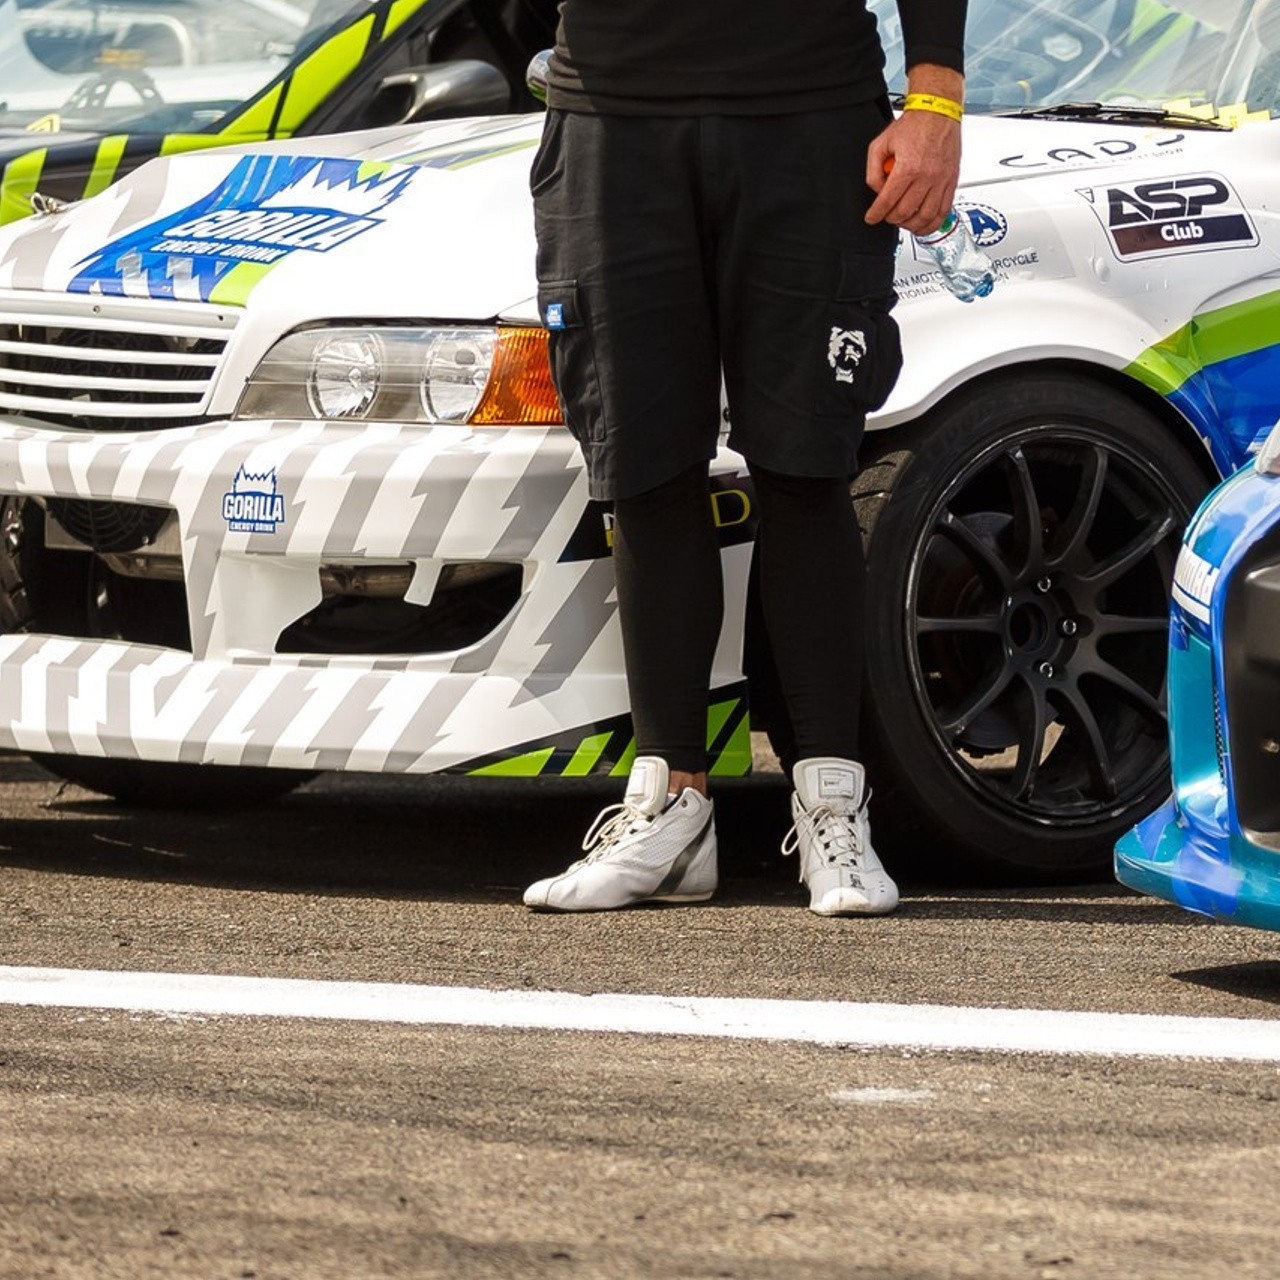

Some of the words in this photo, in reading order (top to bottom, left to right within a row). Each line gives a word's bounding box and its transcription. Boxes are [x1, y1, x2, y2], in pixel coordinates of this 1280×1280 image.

[1107, 177, 1230, 227] ASP
[163, 209, 377, 251] GORILLA
[1161, 223, 1204, 241] Club
[150, 239, 230, 256] ENERGY
[226, 243, 287, 263] DRINK
[223, 494, 283, 521] GORILLA
